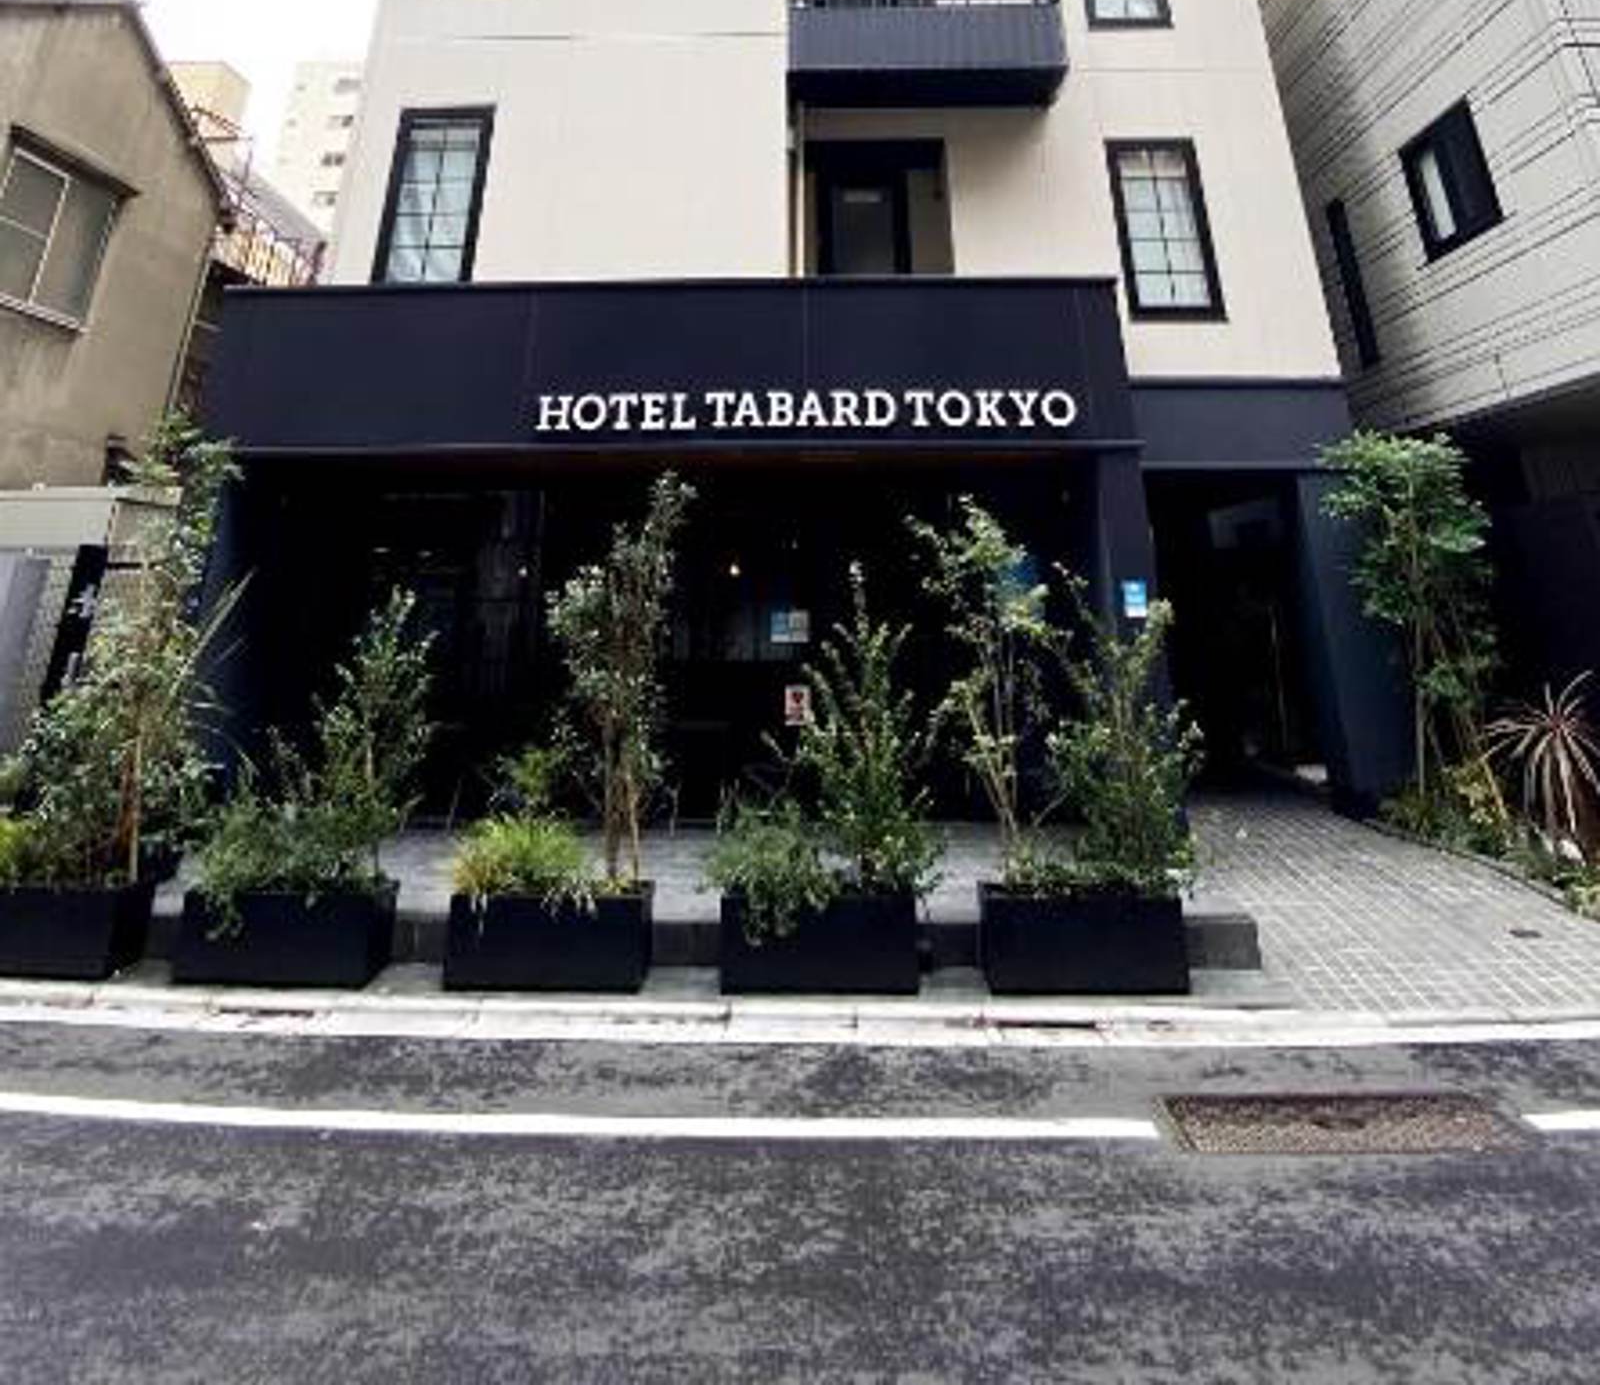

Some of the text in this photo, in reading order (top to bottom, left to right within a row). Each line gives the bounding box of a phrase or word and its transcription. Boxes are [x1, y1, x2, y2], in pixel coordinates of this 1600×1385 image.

[535, 389, 1077, 430] HOTEL TABARD TOKYO
